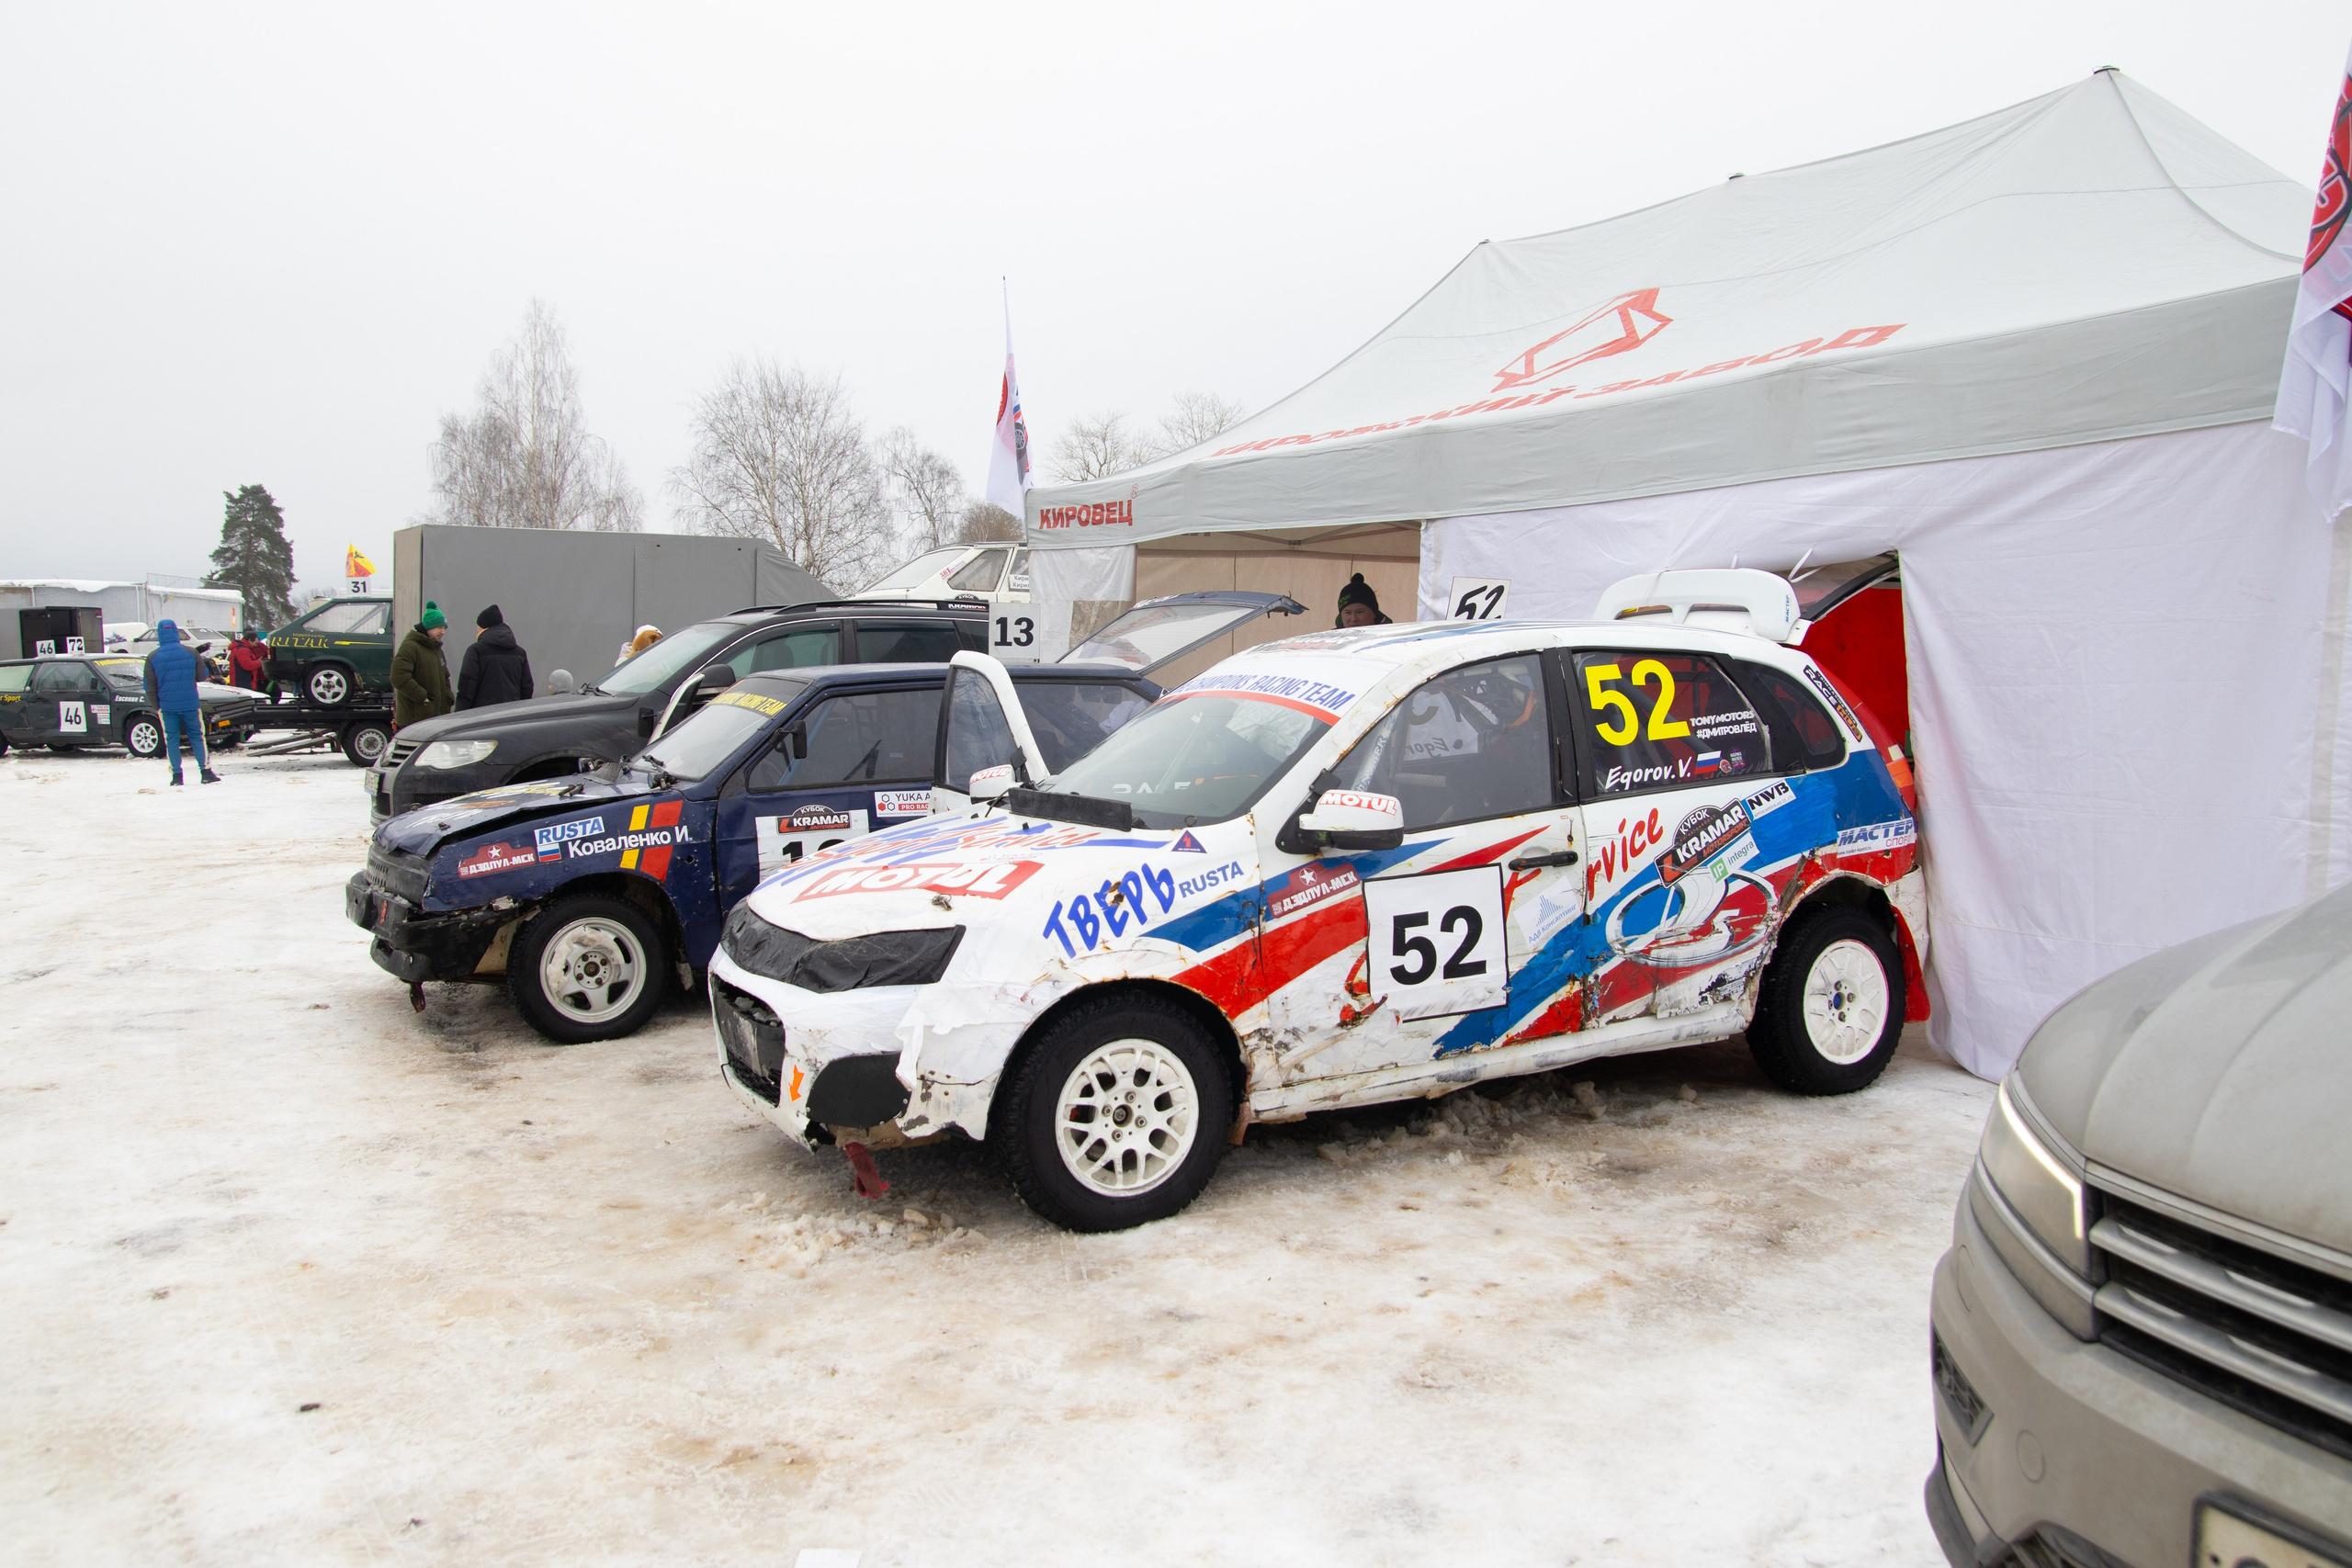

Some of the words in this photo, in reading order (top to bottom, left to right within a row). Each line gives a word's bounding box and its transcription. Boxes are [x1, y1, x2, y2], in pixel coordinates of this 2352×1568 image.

[1573, 323, 1908, 400] ЗАВОД
[1039, 500, 1133, 530] КИРОВЕЦ
[351, 581, 367, 593] 31
[1454, 585, 1505, 620] 52
[68, 638, 84, 651] 72
[994, 616, 1035, 647] 13
[40, 642, 53, 655] 46
[1246, 675, 1309, 696] RACING
[1297, 682, 1356, 711] TEAM
[1804, 667, 1838, 706] RACE
[64, 706, 82, 726] 46
[1585, 660, 1690, 746] 52
[800, 806, 825, 815] КУБОК
[895, 793, 923, 802] YUKA
[1319, 792, 1398, 816] MOTUL
[1747, 782, 1790, 810] NWB
[538, 819, 604, 844] RUSTA
[793, 814, 849, 827] KRAMAR
[1677, 805, 1746, 863] KRAMAR
[1679, 809, 1711, 835] КУБОК
[1838, 819, 1913, 847] МАСТЕР
[568, 830, 672, 859] Коваленко
[675, 826, 693, 842] И.
[1702, 818, 1748, 857] MOTORSPORT
[1727, 840, 1755, 865] integra
[469, 853, 535, 874] ДЭДПУЛ-МСК
[1588, 807, 1664, 902] rvice
[806, 862, 1018, 897] MOTUL
[1180, 861, 1245, 898] RUSTA
[1282, 871, 1358, 911] ДЭДПУЛ-МСК
[1042, 862, 1176, 959] ТВЕРЬ
[1542, 904, 1577, 932] Консалтинг
[1389, 905, 1487, 986] 52
